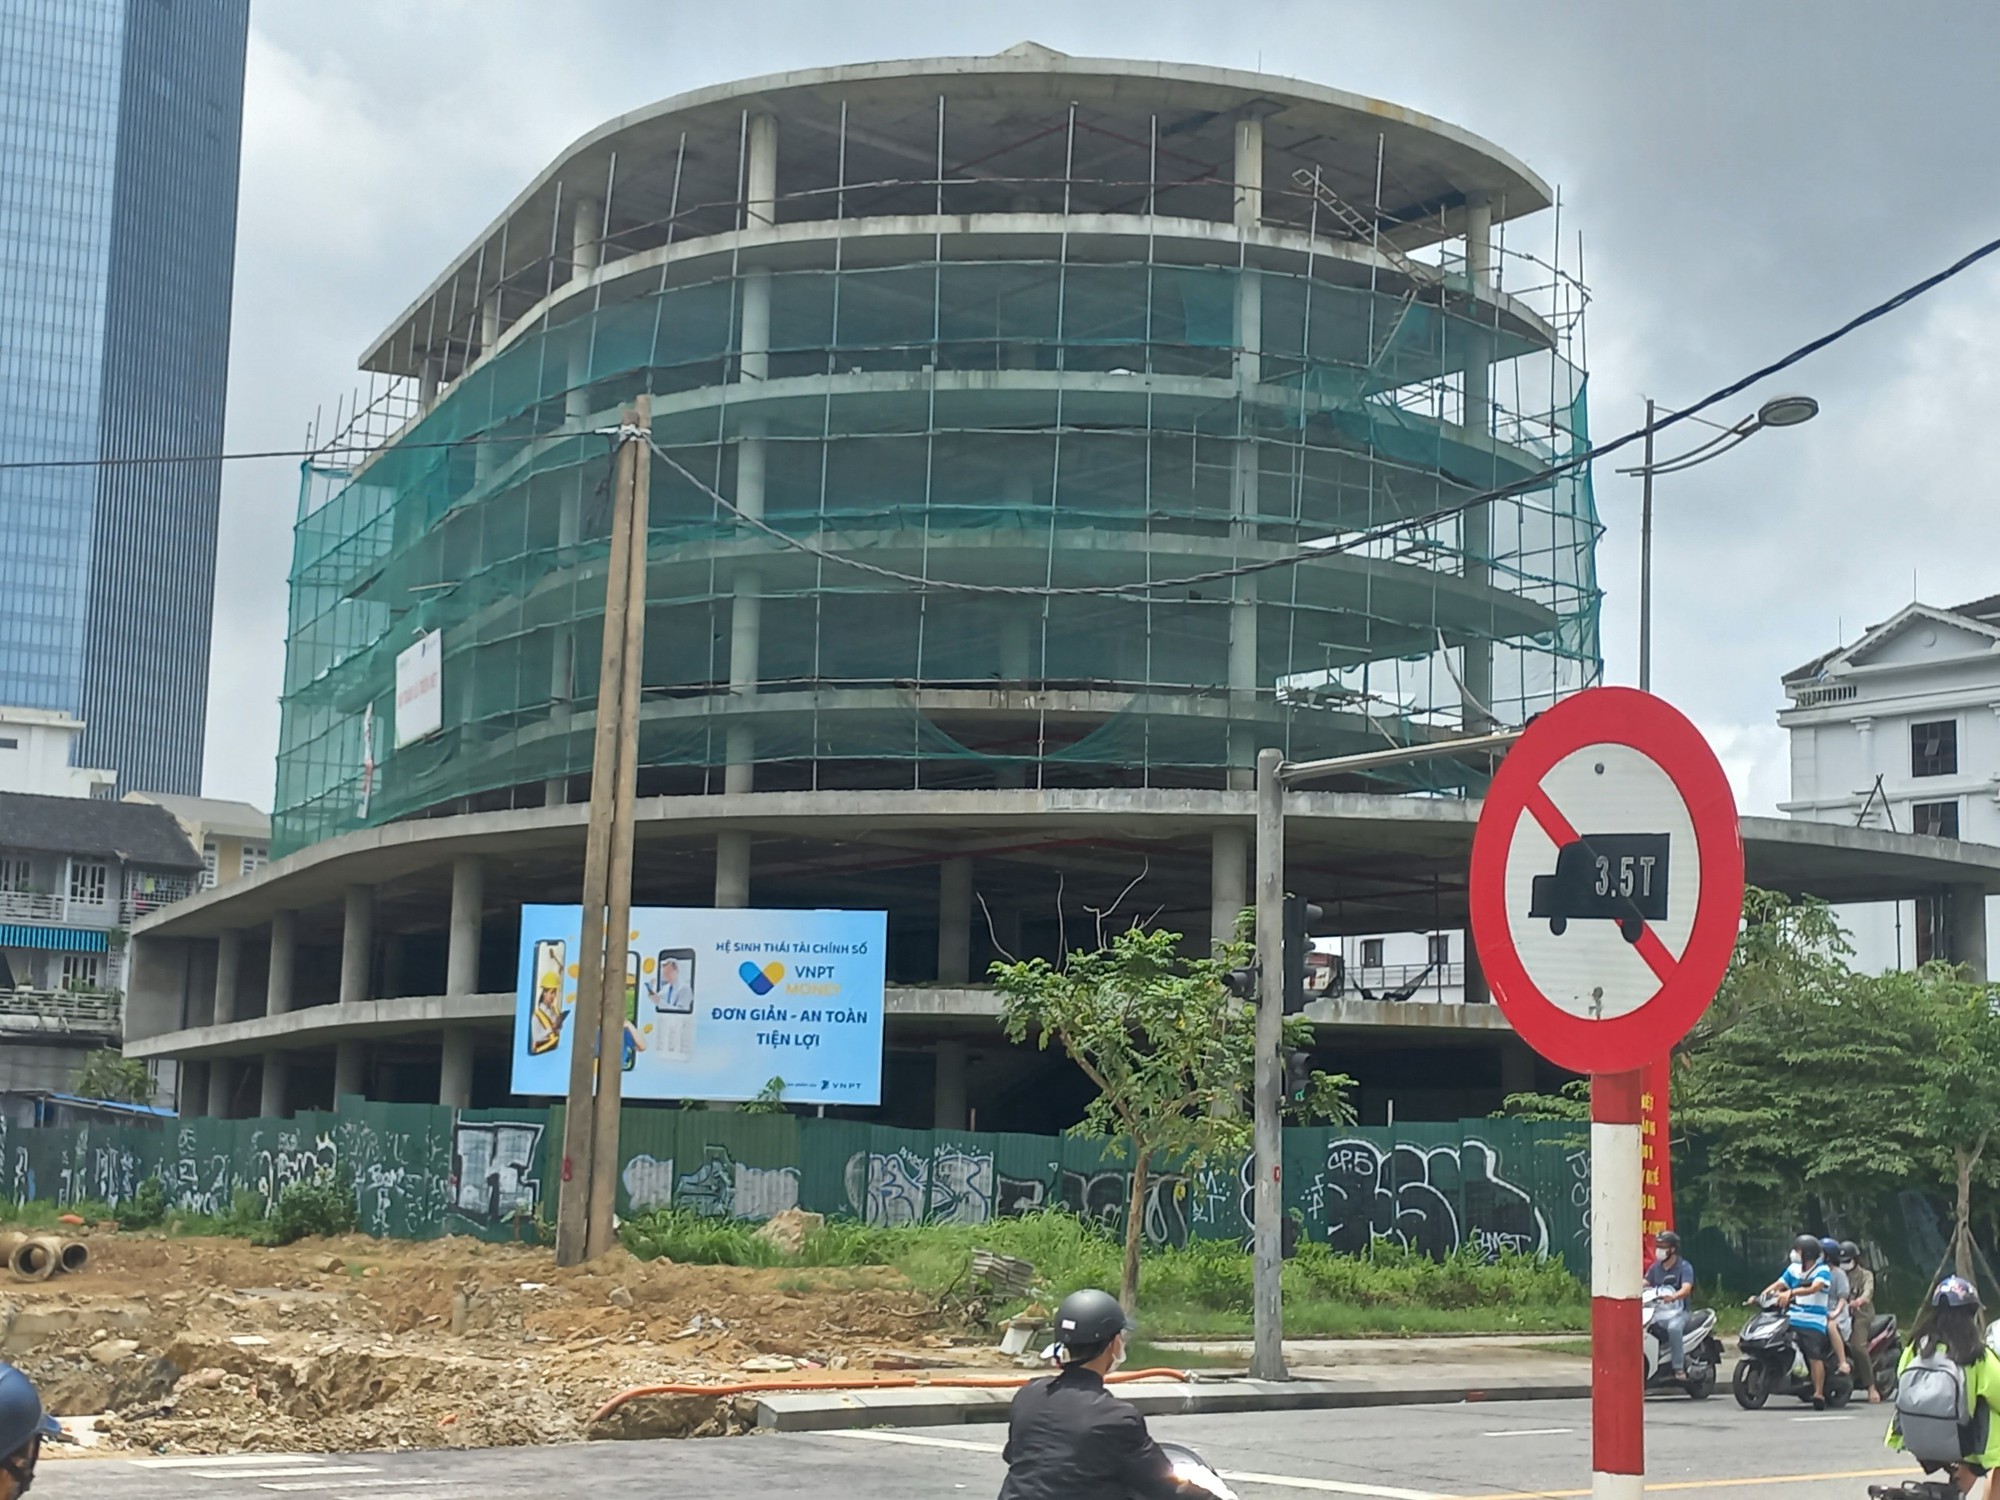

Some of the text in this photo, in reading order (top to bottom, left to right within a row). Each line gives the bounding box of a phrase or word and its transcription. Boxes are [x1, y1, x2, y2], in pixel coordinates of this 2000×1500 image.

[1595, 856, 1656, 897] 3.5T
[716, 940, 868, 955] HỆ SINH THÁI TÀI CHÍNH SỐ
[795, 966, 835, 979] VNPT
[785, 983, 842, 996] MONEY
[712, 1007, 746, 1021] ĐƠN
[750, 1004, 787, 1021] GIẢN
[800, 1010, 822, 1022] AN
[825, 1008, 868, 1023] TOÀN
[756, 1030, 820, 1050] TIỆN LỢI
[832, 1082, 862, 1090] VNPT
